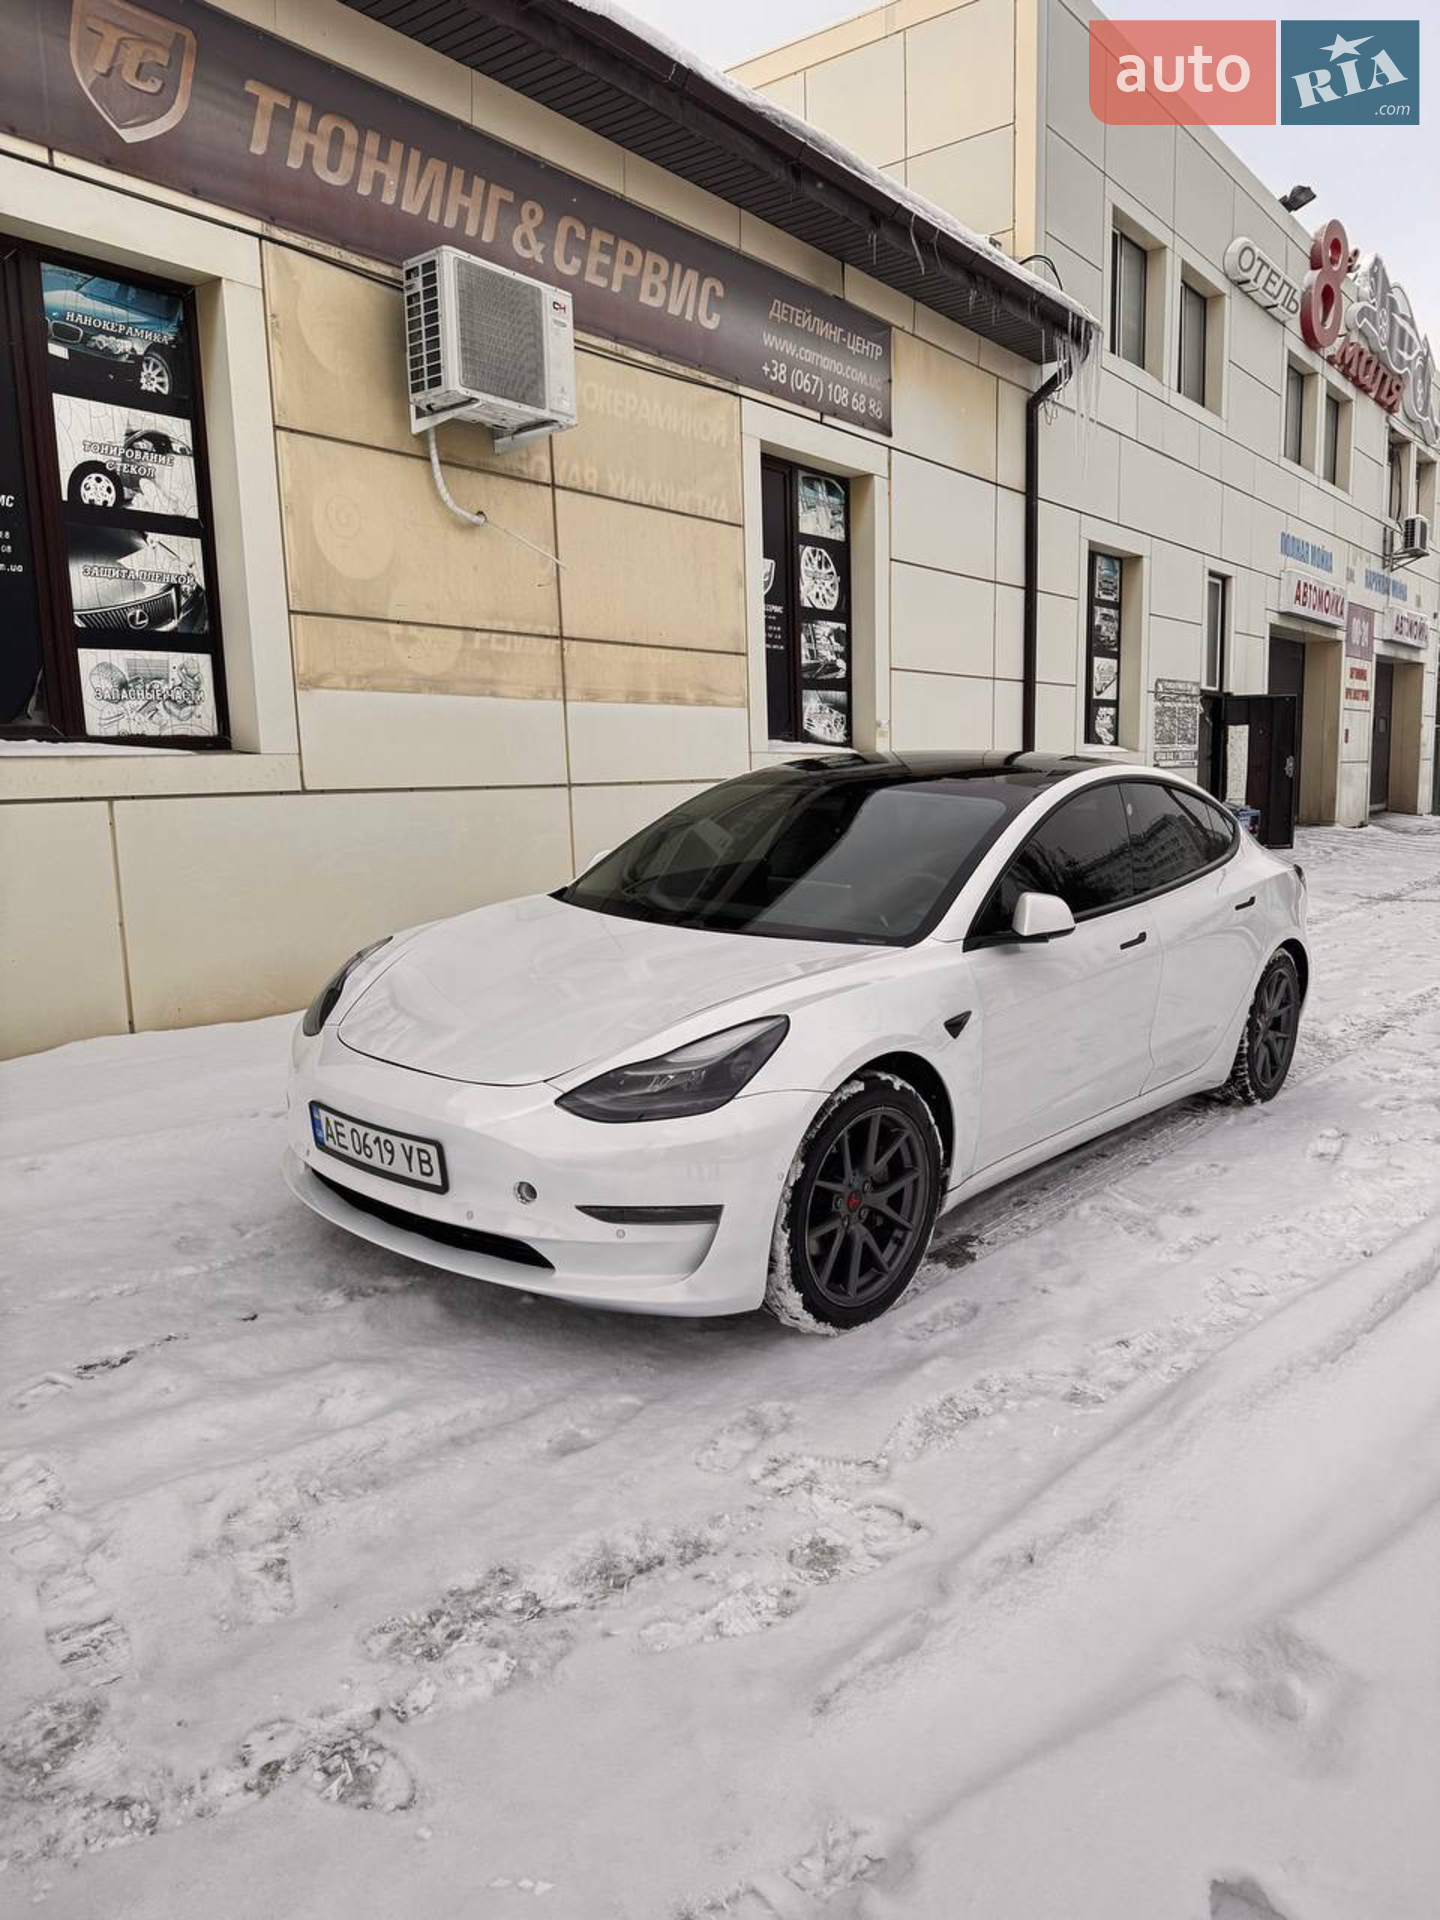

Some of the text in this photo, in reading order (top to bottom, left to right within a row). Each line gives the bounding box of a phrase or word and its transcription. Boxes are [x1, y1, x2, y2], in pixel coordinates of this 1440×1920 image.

[1238, 245, 1300, 316] ОТЕЛЬ
[66, 311, 170, 345] НАНОКЕРАМИКА
[768, 299, 883, 361] ДЕТЕЙЛИНГ-ЦЕНТР
[762, 359, 788, 385] +38
[790, 367, 824, 402] (067)
[827, 381, 849, 408] 108
[851, 392, 867, 414] 68
[82, 441, 175, 466] ТОНИРОВАНИЕ
[105, 461, 156, 478] СТЕКОЛ
[82, 565, 196, 586] ЗАЩИТА ПЛЕНКОЙ
[1294, 580, 1345, 620] АВТОМОЙКА
[95, 687, 205, 704] ЗАПАСНЫЕ ЧАСТИ
[325, 1117, 434, 1177] AE 0619 YB
